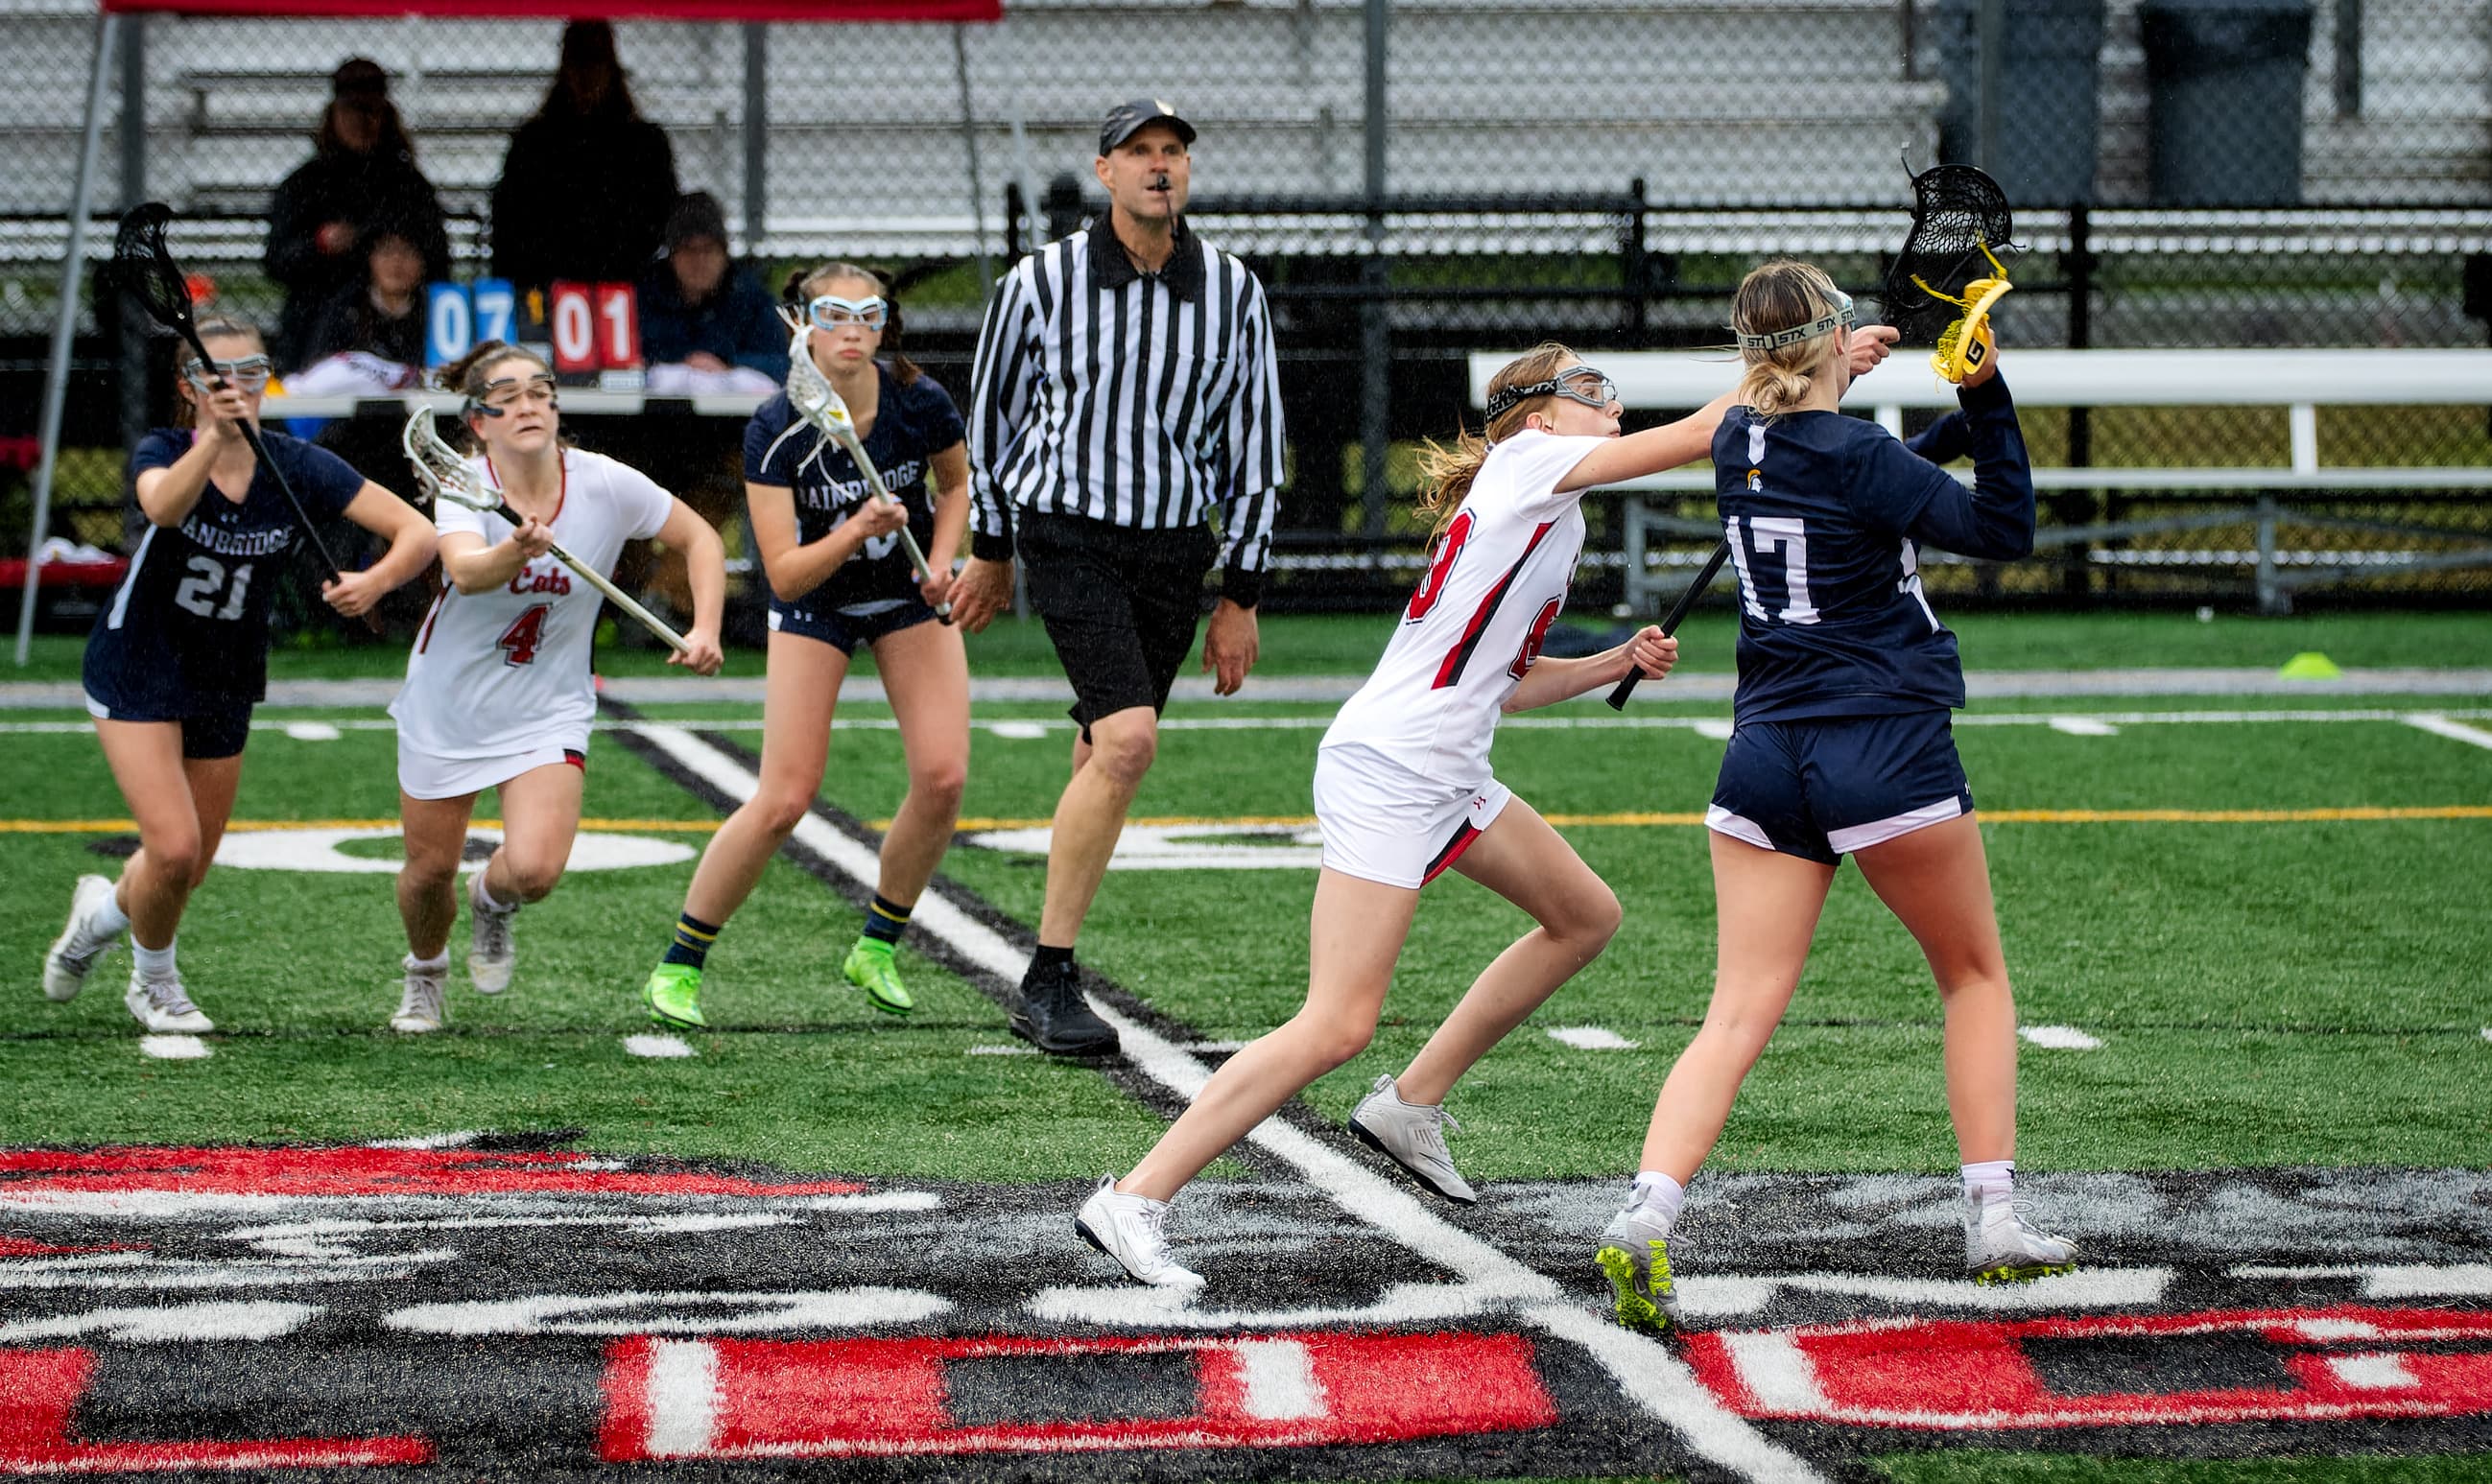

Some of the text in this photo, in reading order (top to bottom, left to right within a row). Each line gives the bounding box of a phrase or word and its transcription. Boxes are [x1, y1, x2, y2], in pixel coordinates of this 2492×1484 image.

[432, 290, 516, 362] 07
[555, 290, 631, 363] 01
[1778, 328, 1807, 343] STX
[1816, 317, 1837, 332] STX
[1840, 308, 1856, 322] STX
[175, 555, 253, 621] 21
[509, 565, 572, 596] Cats
[1724, 515, 1822, 625] 17
[496, 601, 554, 668] 4
